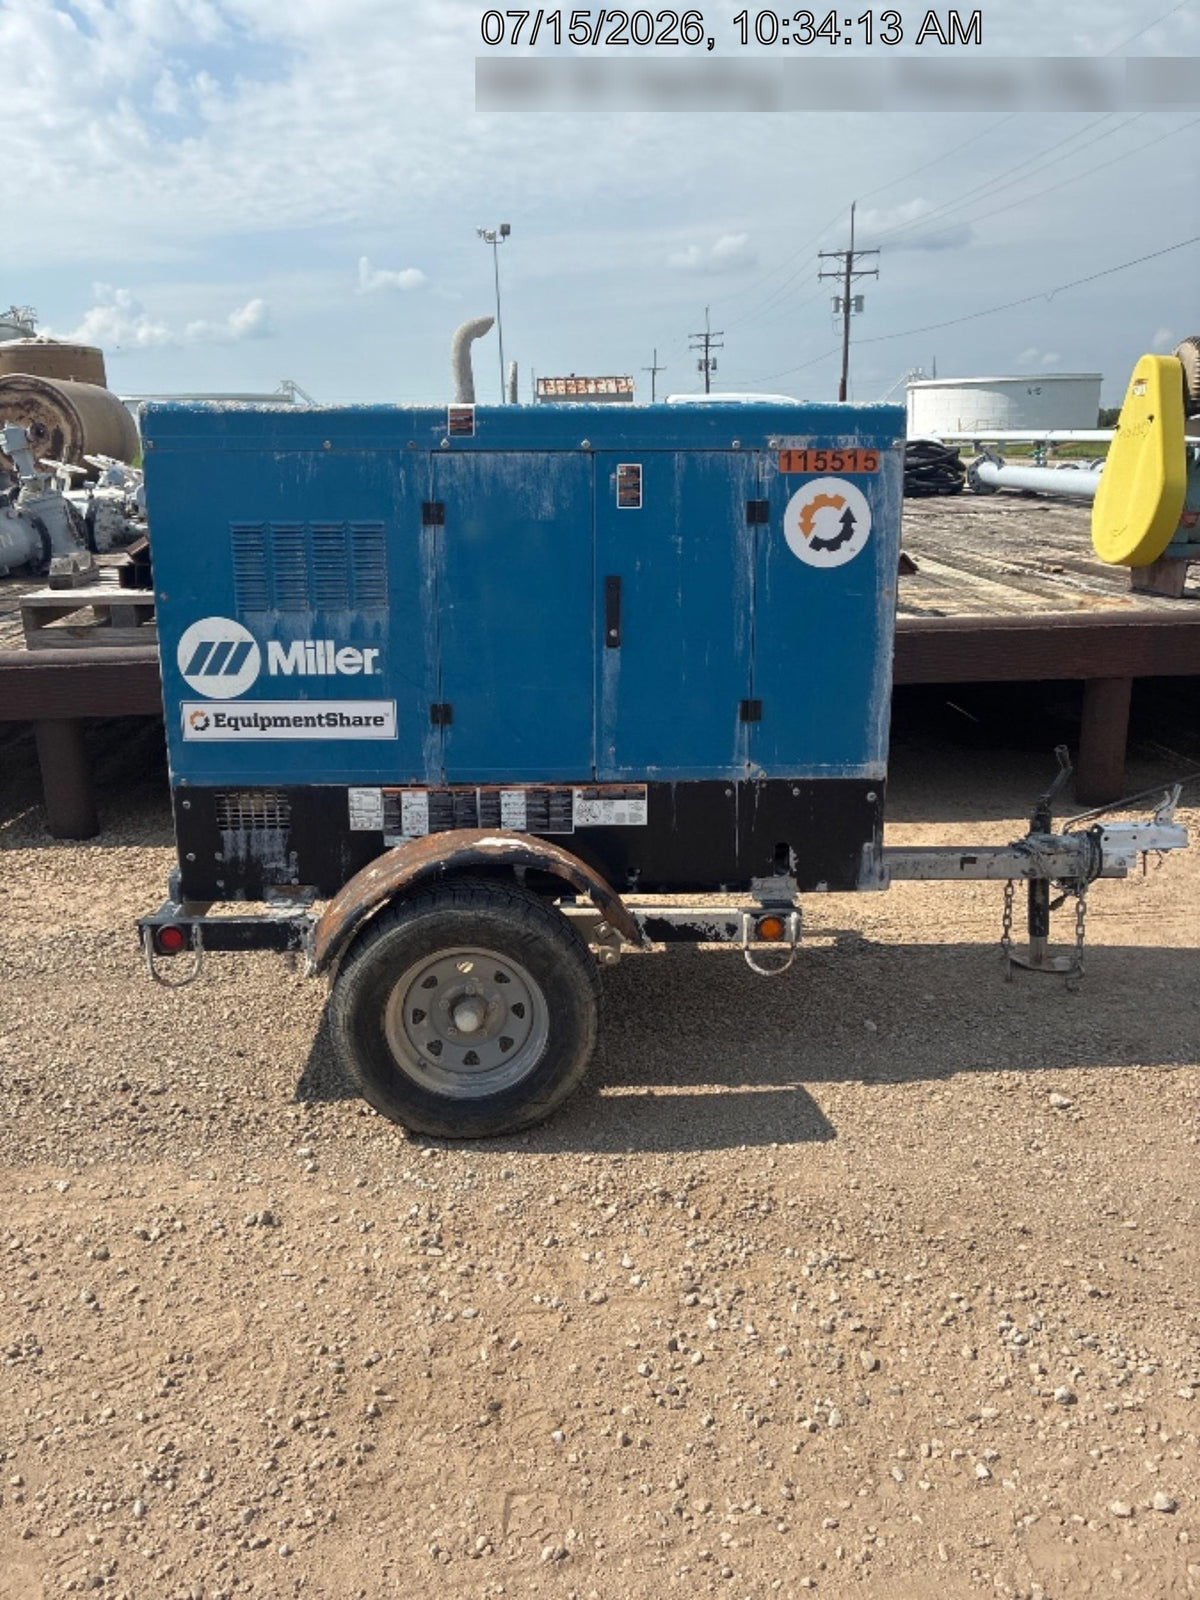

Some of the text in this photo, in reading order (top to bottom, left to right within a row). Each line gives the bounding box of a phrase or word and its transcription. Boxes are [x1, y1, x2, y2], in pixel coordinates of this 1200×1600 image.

[782, 449, 877, 471] 115515
[267, 640, 380, 676] Miller
[213, 712, 385, 731] EquipmentShare
